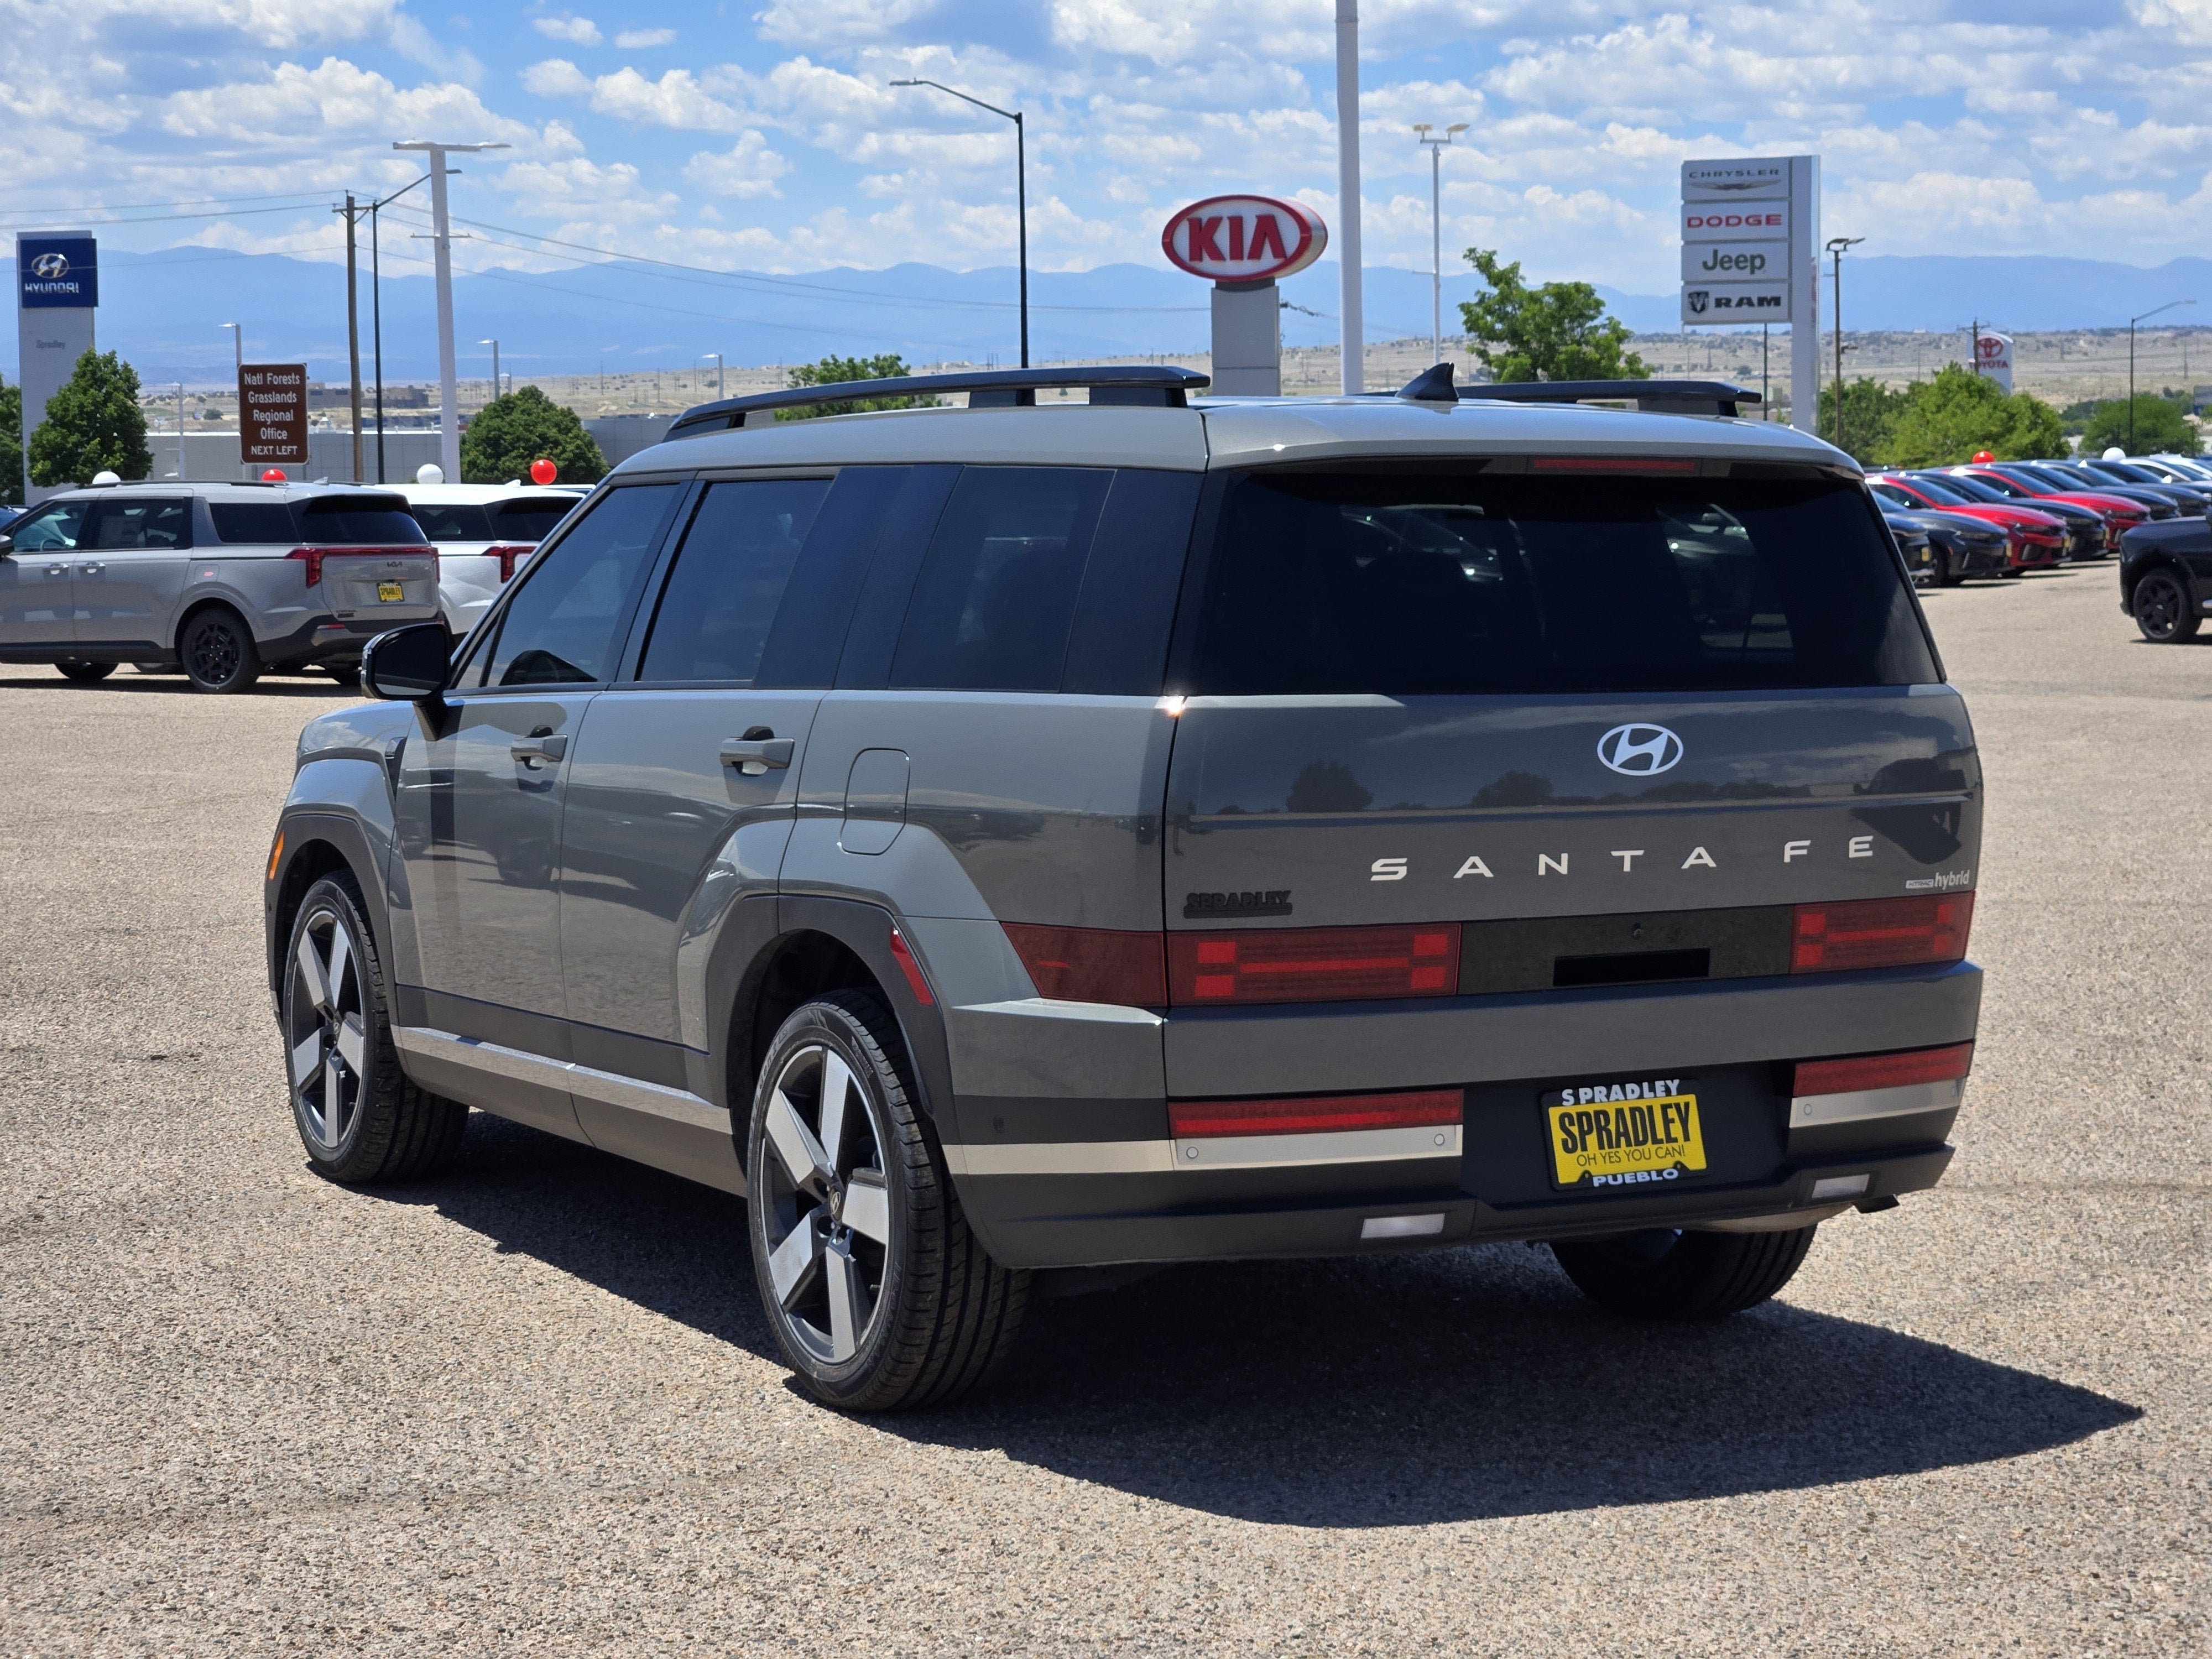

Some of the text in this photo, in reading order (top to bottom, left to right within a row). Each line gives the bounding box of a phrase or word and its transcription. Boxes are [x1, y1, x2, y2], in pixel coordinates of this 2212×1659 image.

[1689, 168, 1780, 179] CHRYSLER
[1687, 213, 1782, 228] DODGE
[1186, 213, 1287, 263] KIA
[1702, 249, 1766, 275] Jeep
[25, 282, 80, 294] HYUNDAI
[1714, 295, 1782, 309] RAM
[244, 372, 300, 385] Natl Forests
[248, 391, 298, 404] Grasslands
[253, 409, 294, 425] Regional
[260, 427, 288, 440] Office
[251, 446, 298, 455] NEXT LEFT
[1370, 836, 1874, 881] SANTA FE
[1934, 869, 1970, 890] hybrid
[1186, 890, 1292, 908] SPRADLEY
[1562, 1079, 1680, 1106] SPRADLEY
[1558, 1100, 1691, 1155] SPRADLEY
[1576, 1144, 1686, 1167] OH YES YOU CAN!
[1593, 1168, 1679, 1187] PUEBLO
